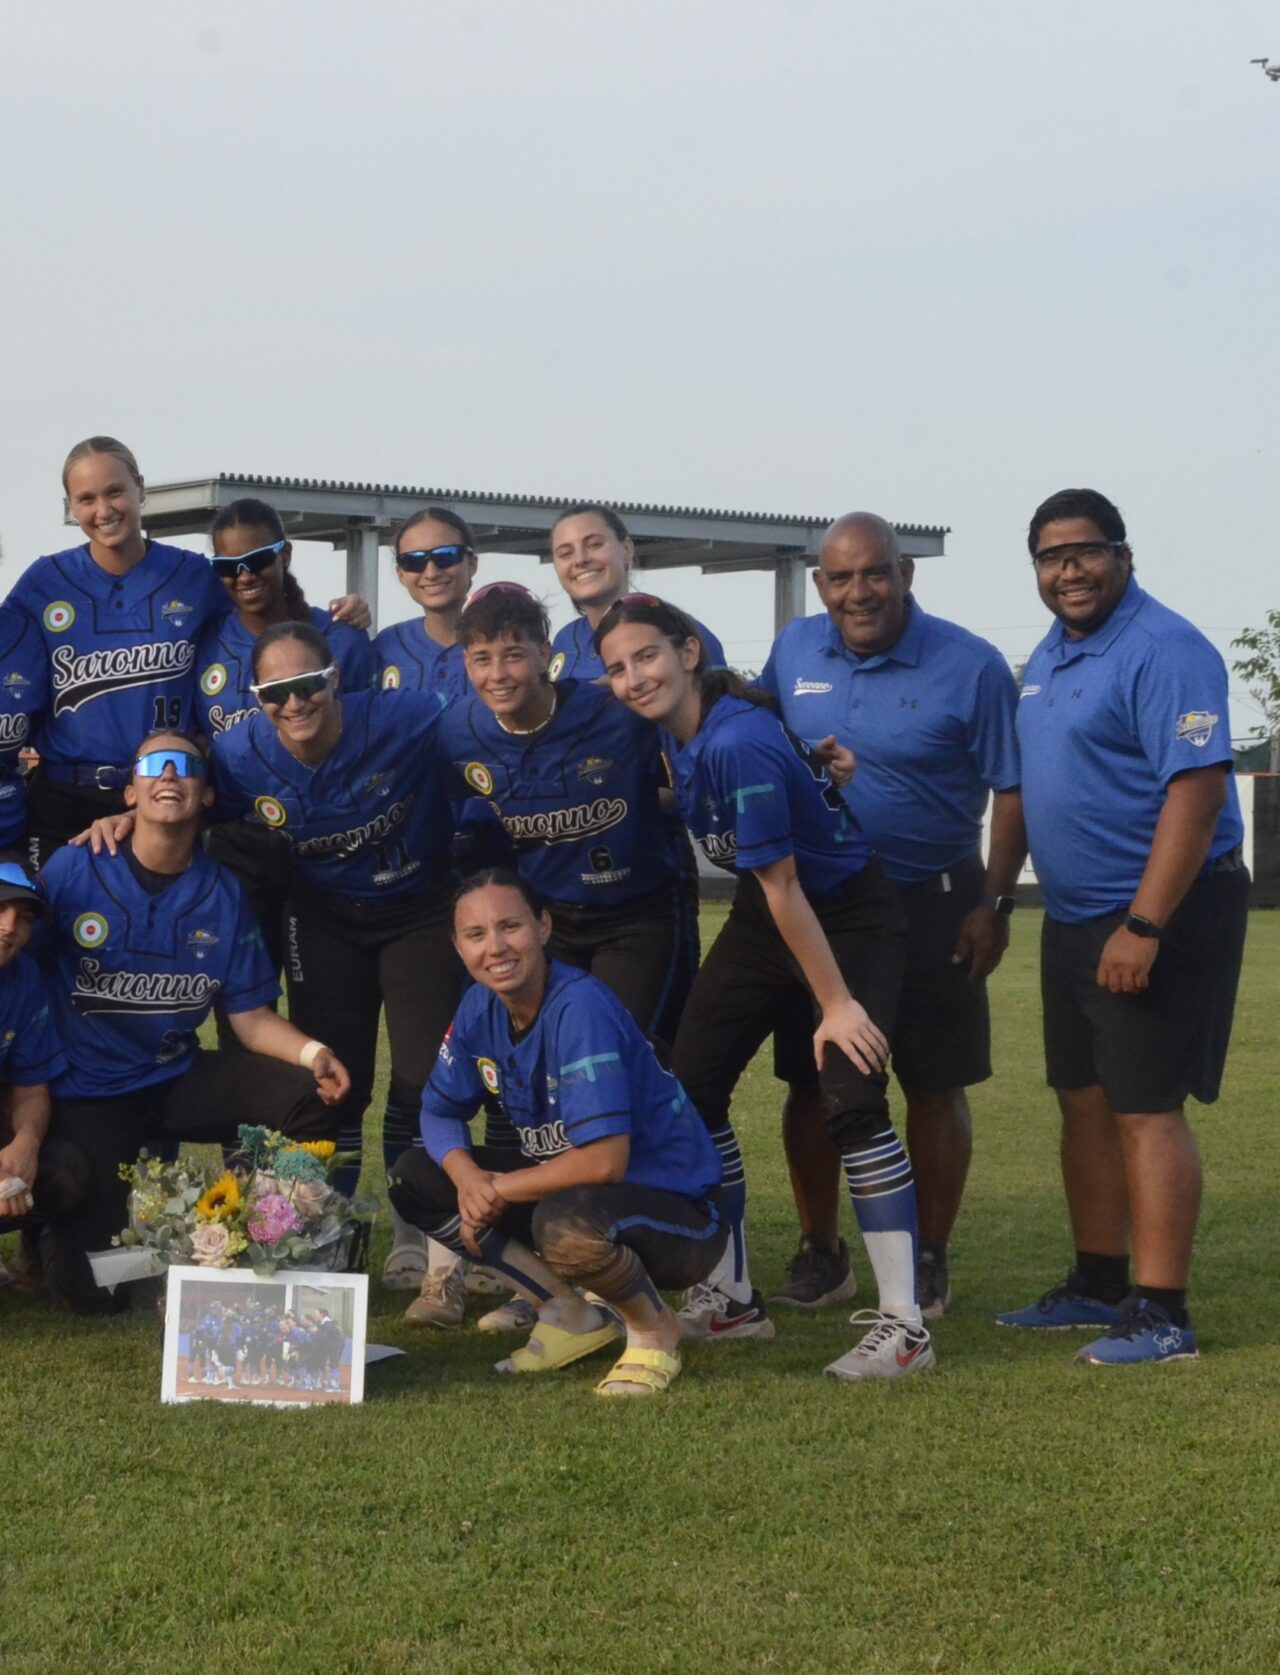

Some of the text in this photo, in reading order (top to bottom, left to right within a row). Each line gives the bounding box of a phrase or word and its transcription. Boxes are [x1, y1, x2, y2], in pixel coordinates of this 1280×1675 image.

[52, 639, 196, 689] Saronno
[153, 696, 182, 731] 19
[75, 956, 221, 1002] Saronno
